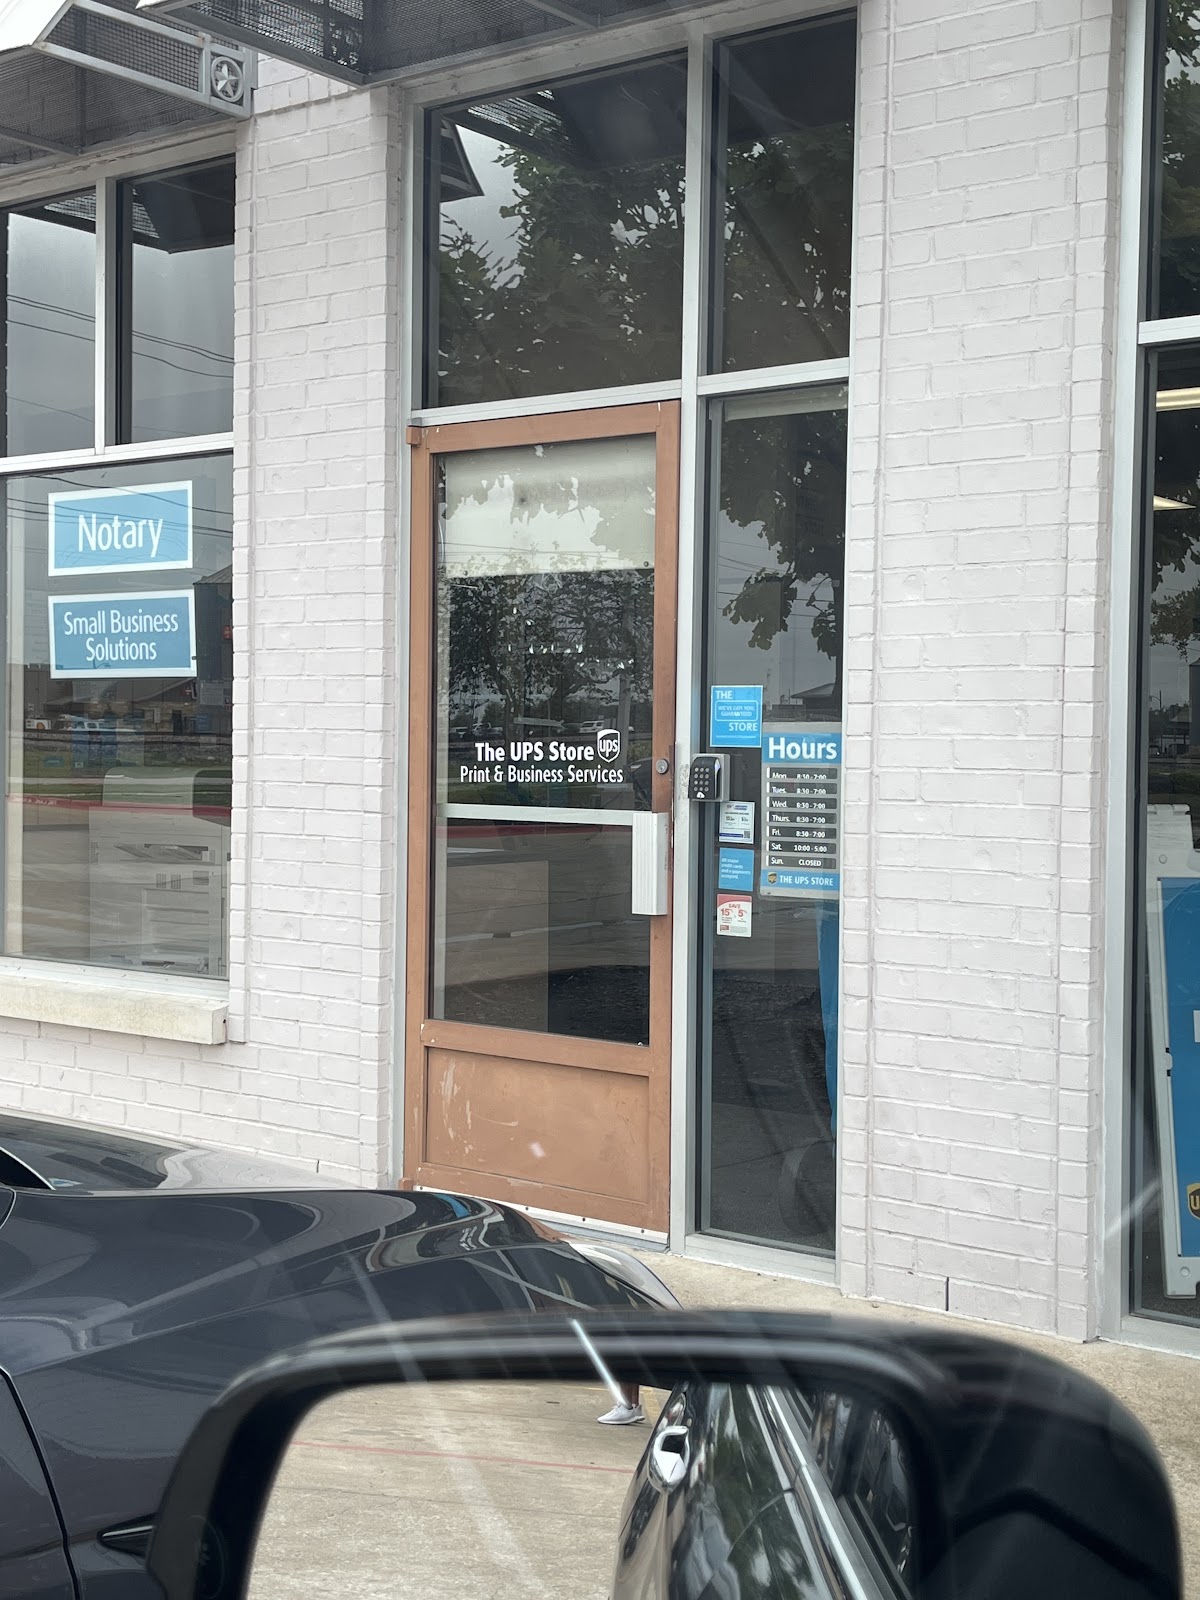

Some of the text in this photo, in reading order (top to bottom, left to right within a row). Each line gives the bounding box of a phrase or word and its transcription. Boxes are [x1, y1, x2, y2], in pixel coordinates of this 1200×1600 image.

[78, 513, 163, 557] Notary
[64, 609, 178, 635] Small Business
[86, 637, 157, 661] Solutions
[716, 691, 732, 699] THE
[729, 723, 758, 731] STORE
[475, 742, 594, 761] The UPS Store
[599, 740, 618, 757] ups
[768, 737, 837, 760] Hours
[461, 765, 623, 783] Print & Business Services
[771, 843, 782, 851] Sat.
[780, 875, 792, 884] THE
[795, 876, 809, 885] UPS
[811, 878, 833, 886] STORE
